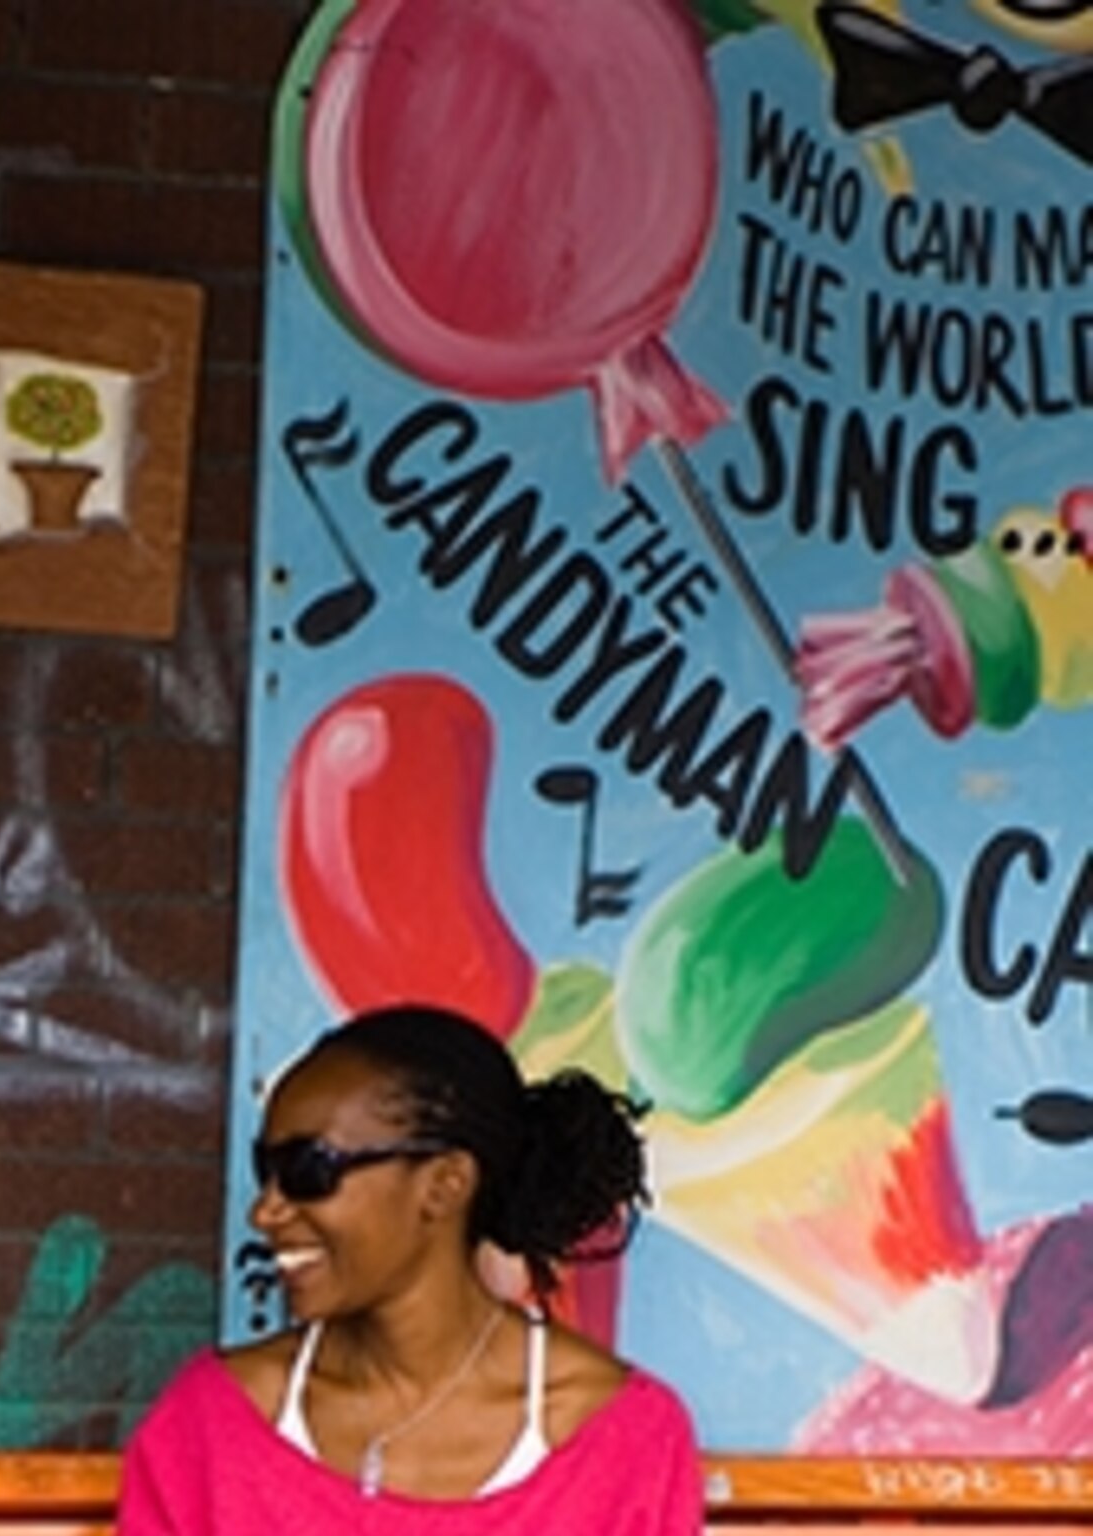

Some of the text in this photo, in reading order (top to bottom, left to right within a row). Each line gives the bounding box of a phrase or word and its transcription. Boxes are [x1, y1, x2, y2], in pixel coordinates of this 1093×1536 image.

[745, 90, 862, 244] WHO
[883, 196, 995, 286] CAN
[737, 212, 846, 374] THE
[367, 402, 851, 882] CANDYMAN
[596, 482, 720, 630] THE
